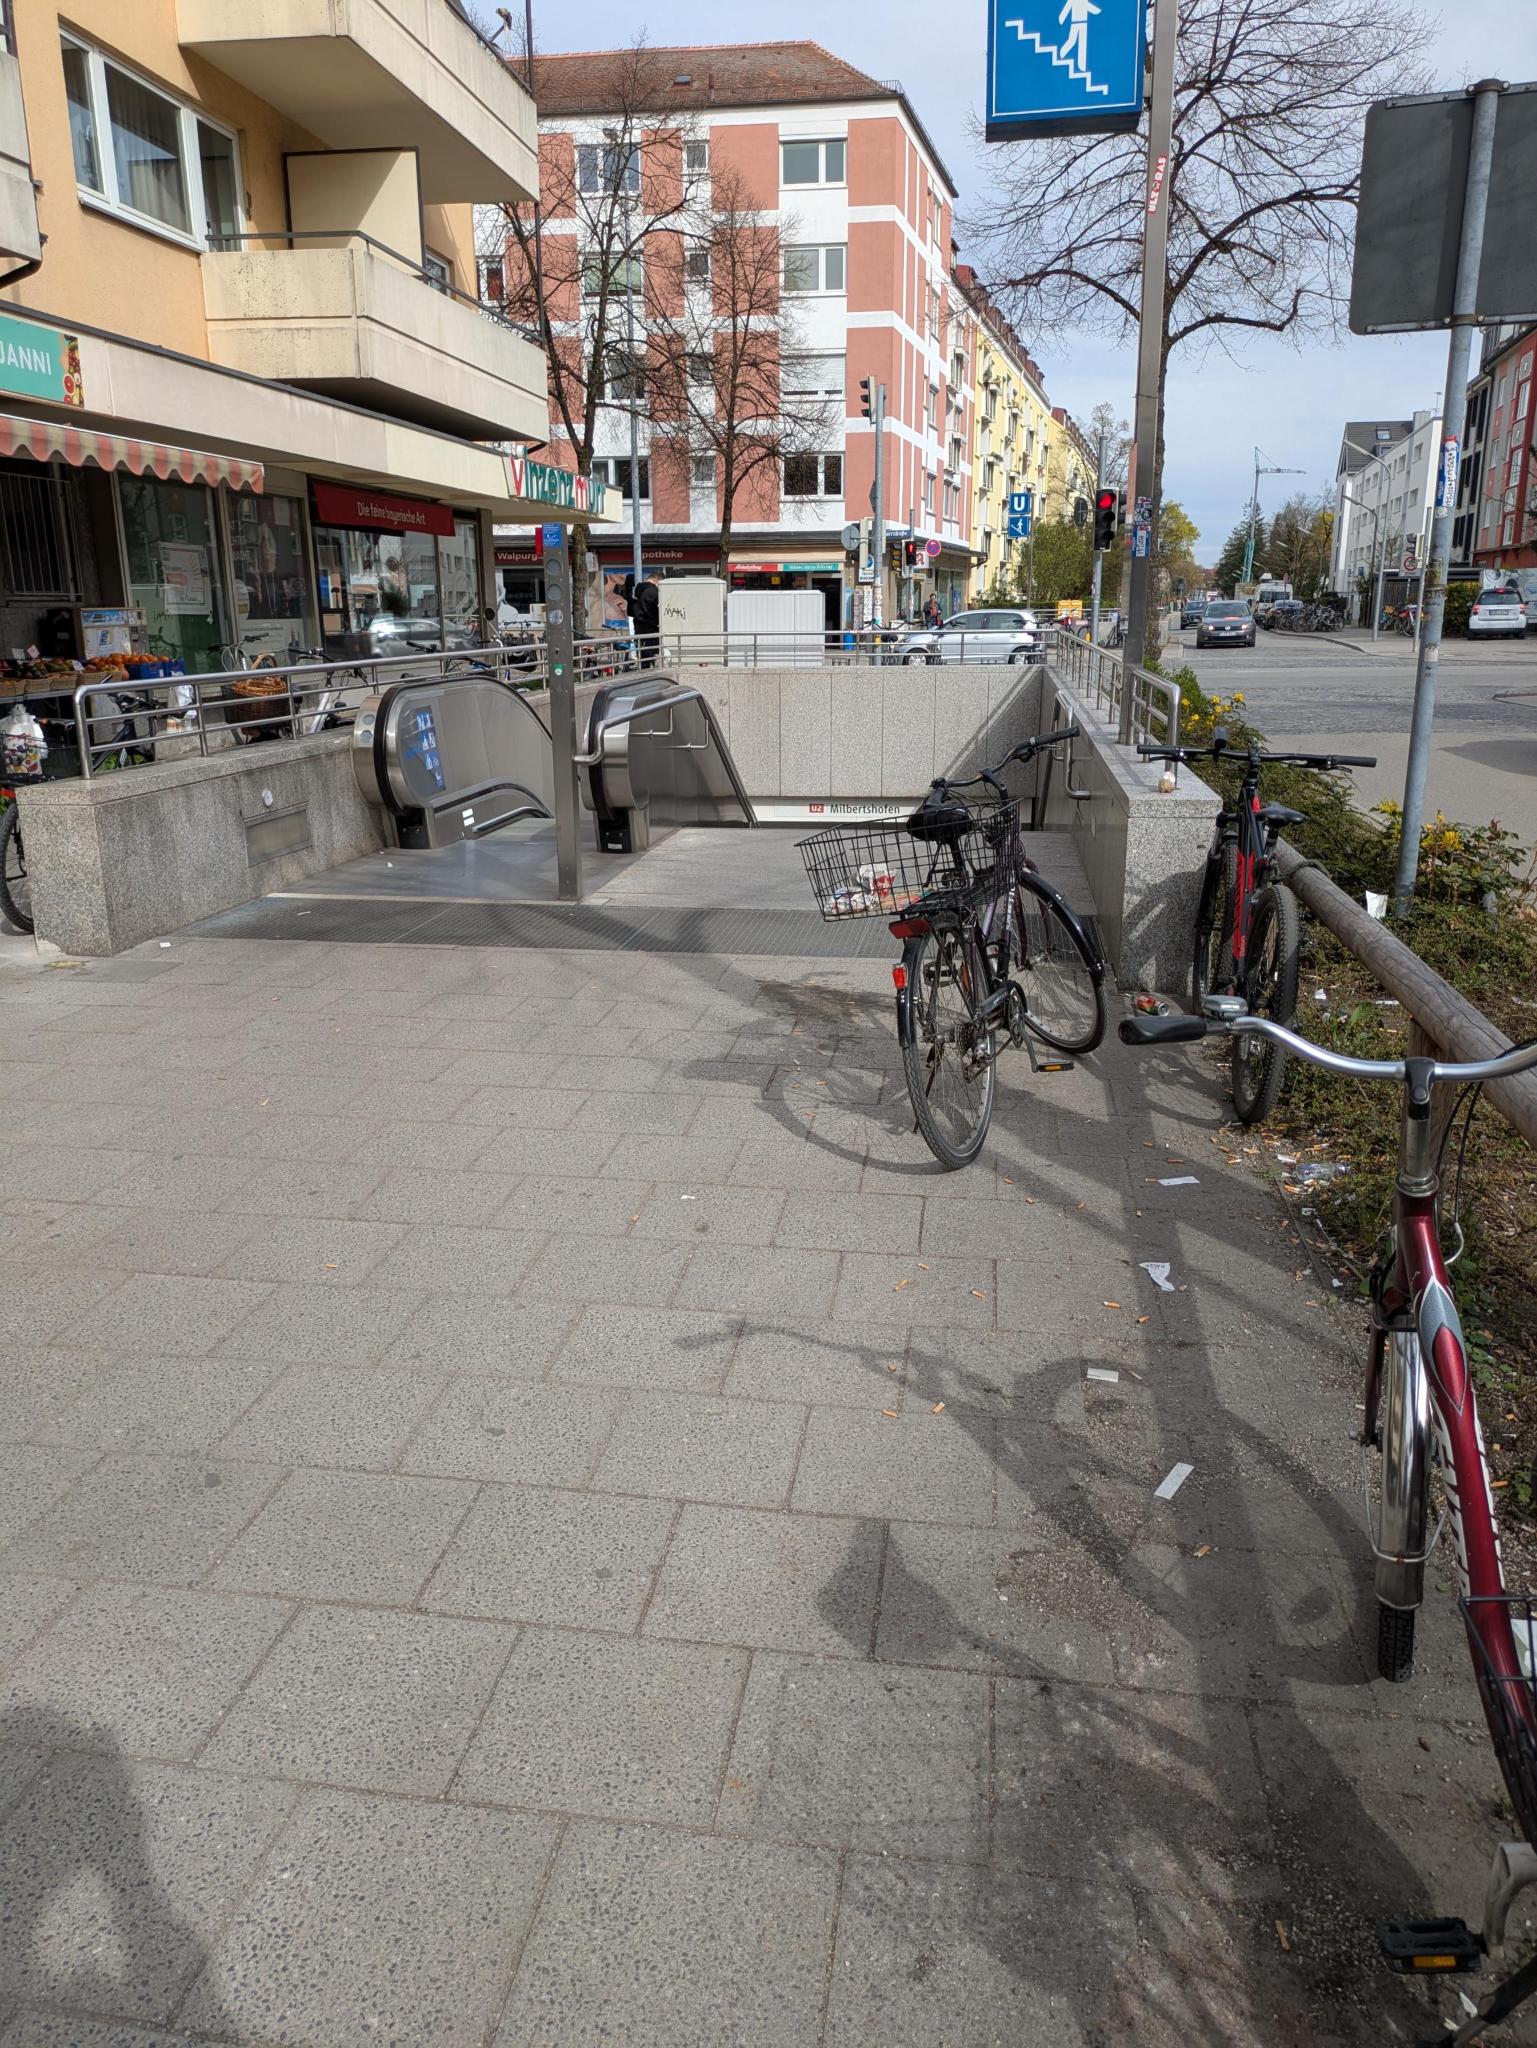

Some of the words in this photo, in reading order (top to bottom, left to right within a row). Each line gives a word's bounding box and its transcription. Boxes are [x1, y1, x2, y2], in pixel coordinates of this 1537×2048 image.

[1014, 496, 1025, 511] U
[357, 502, 369, 516] Die
[370, 504, 386, 518] feine
[416, 513, 425, 525] Art
[497, 552, 543, 561] Walpurg
[642, 550, 684, 560] potheke
[830, 804, 900, 814] Milbertshofen
